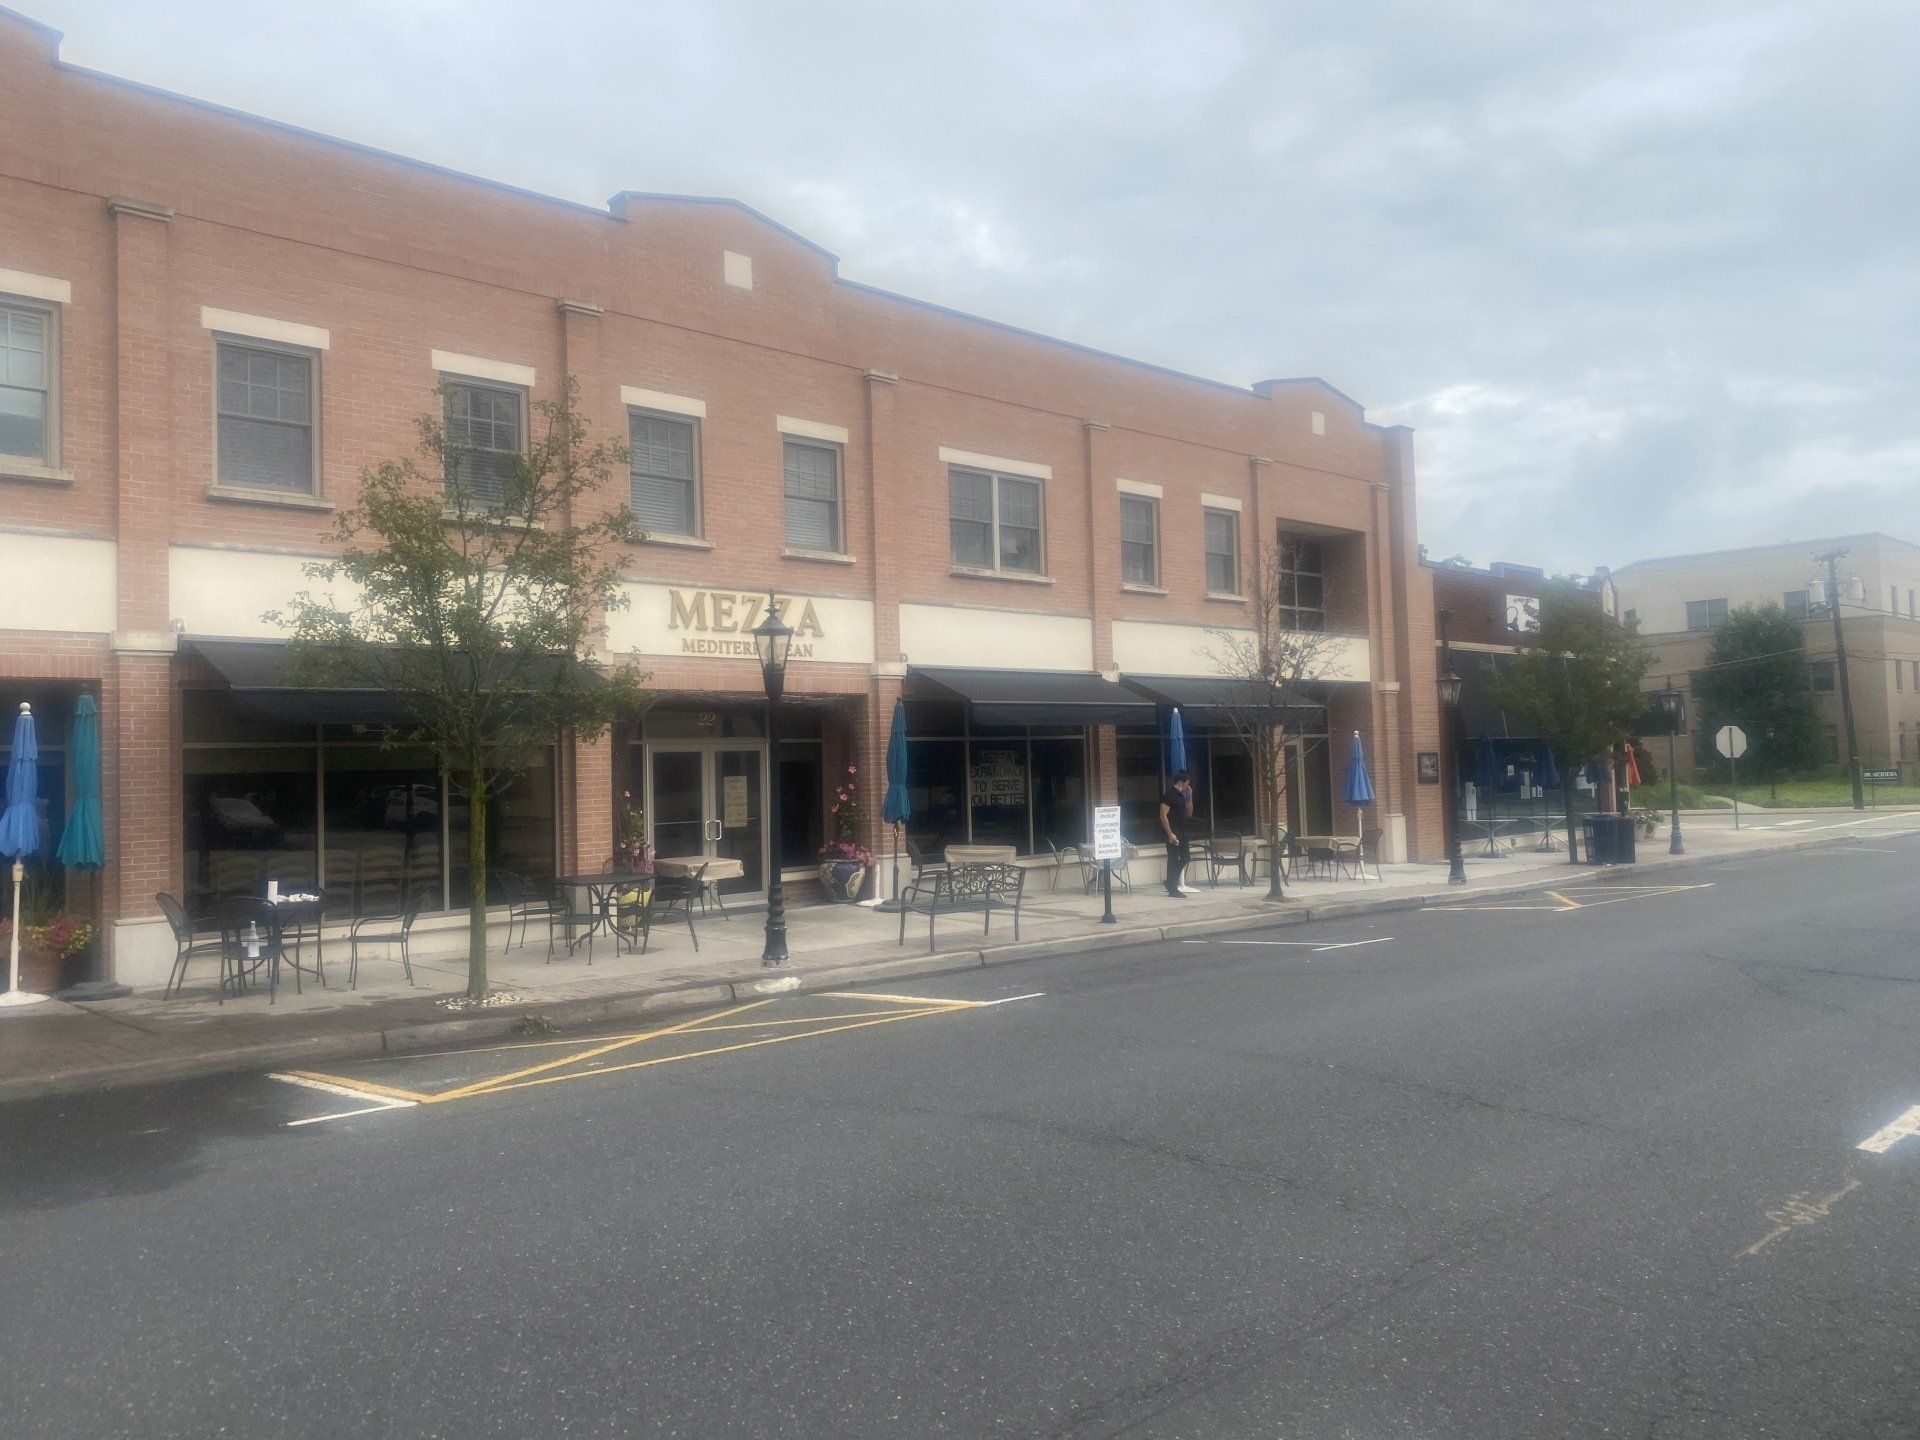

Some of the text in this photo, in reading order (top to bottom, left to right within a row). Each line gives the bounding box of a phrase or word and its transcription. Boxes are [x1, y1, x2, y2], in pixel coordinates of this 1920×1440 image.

[668, 589, 825, 637] MEZZA
[682, 638, 813, 657] MEDITEREAN
[697, 712, 716, 725] 22
[973, 780, 1021, 792] TO SERVE
